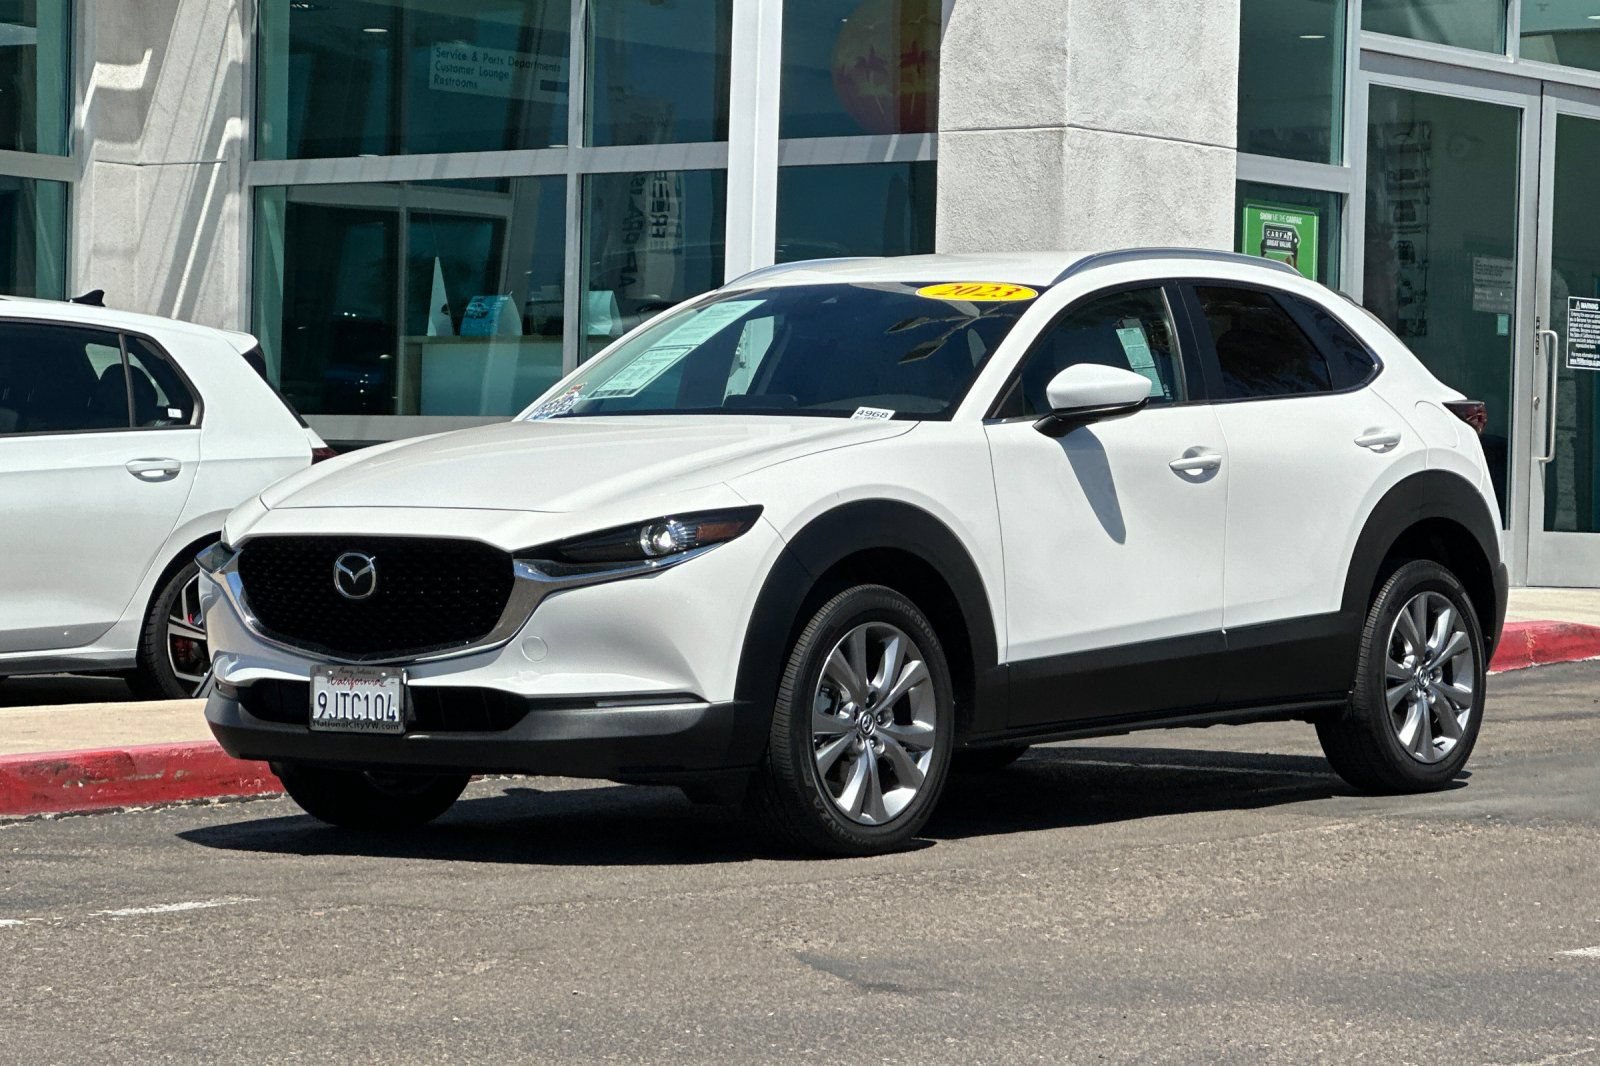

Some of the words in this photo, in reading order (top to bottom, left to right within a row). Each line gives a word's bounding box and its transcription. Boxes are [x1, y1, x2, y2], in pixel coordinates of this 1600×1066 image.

[435, 47, 468, 61] Service
[471, 51, 478, 62] &
[483, 52, 504, 66] Parts
[507, 56, 561, 73] Departments
[434, 60, 475, 76] Customer
[479, 66, 510, 81] Lounge
[433, 73, 478, 89] Restrooms
[934, 285, 1023, 298] 2023
[330, 676, 387, 690] California
[317, 691, 397, 721] 9JTC104
[312, 720, 400, 731] NationalCityVW.com
